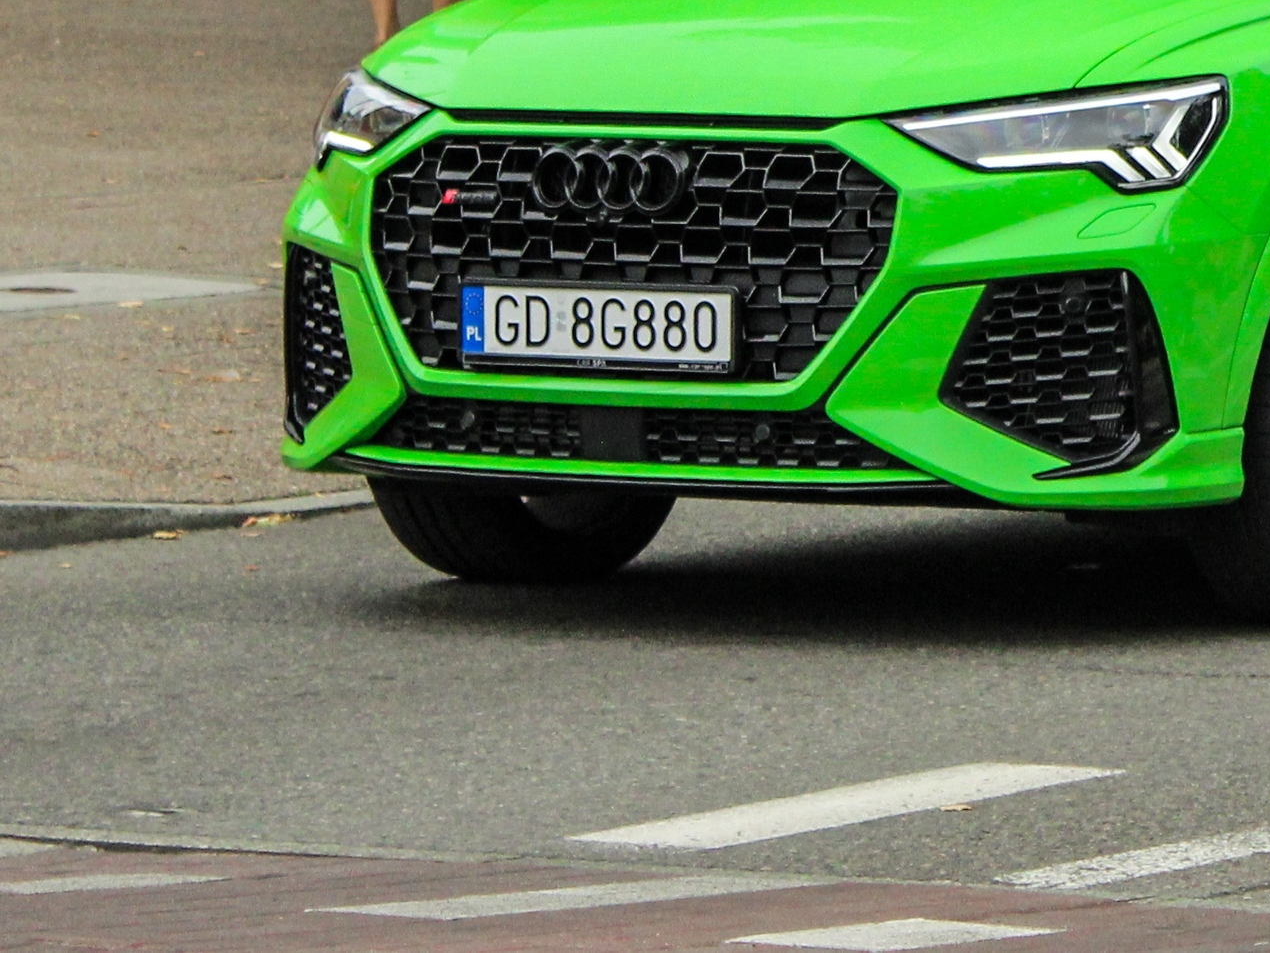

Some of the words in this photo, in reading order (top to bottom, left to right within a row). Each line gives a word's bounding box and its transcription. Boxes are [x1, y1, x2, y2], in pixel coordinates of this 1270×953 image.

[466, 326, 482, 342] PL
[495, 295, 551, 348] GD
[571, 296, 718, 353] 8G880
